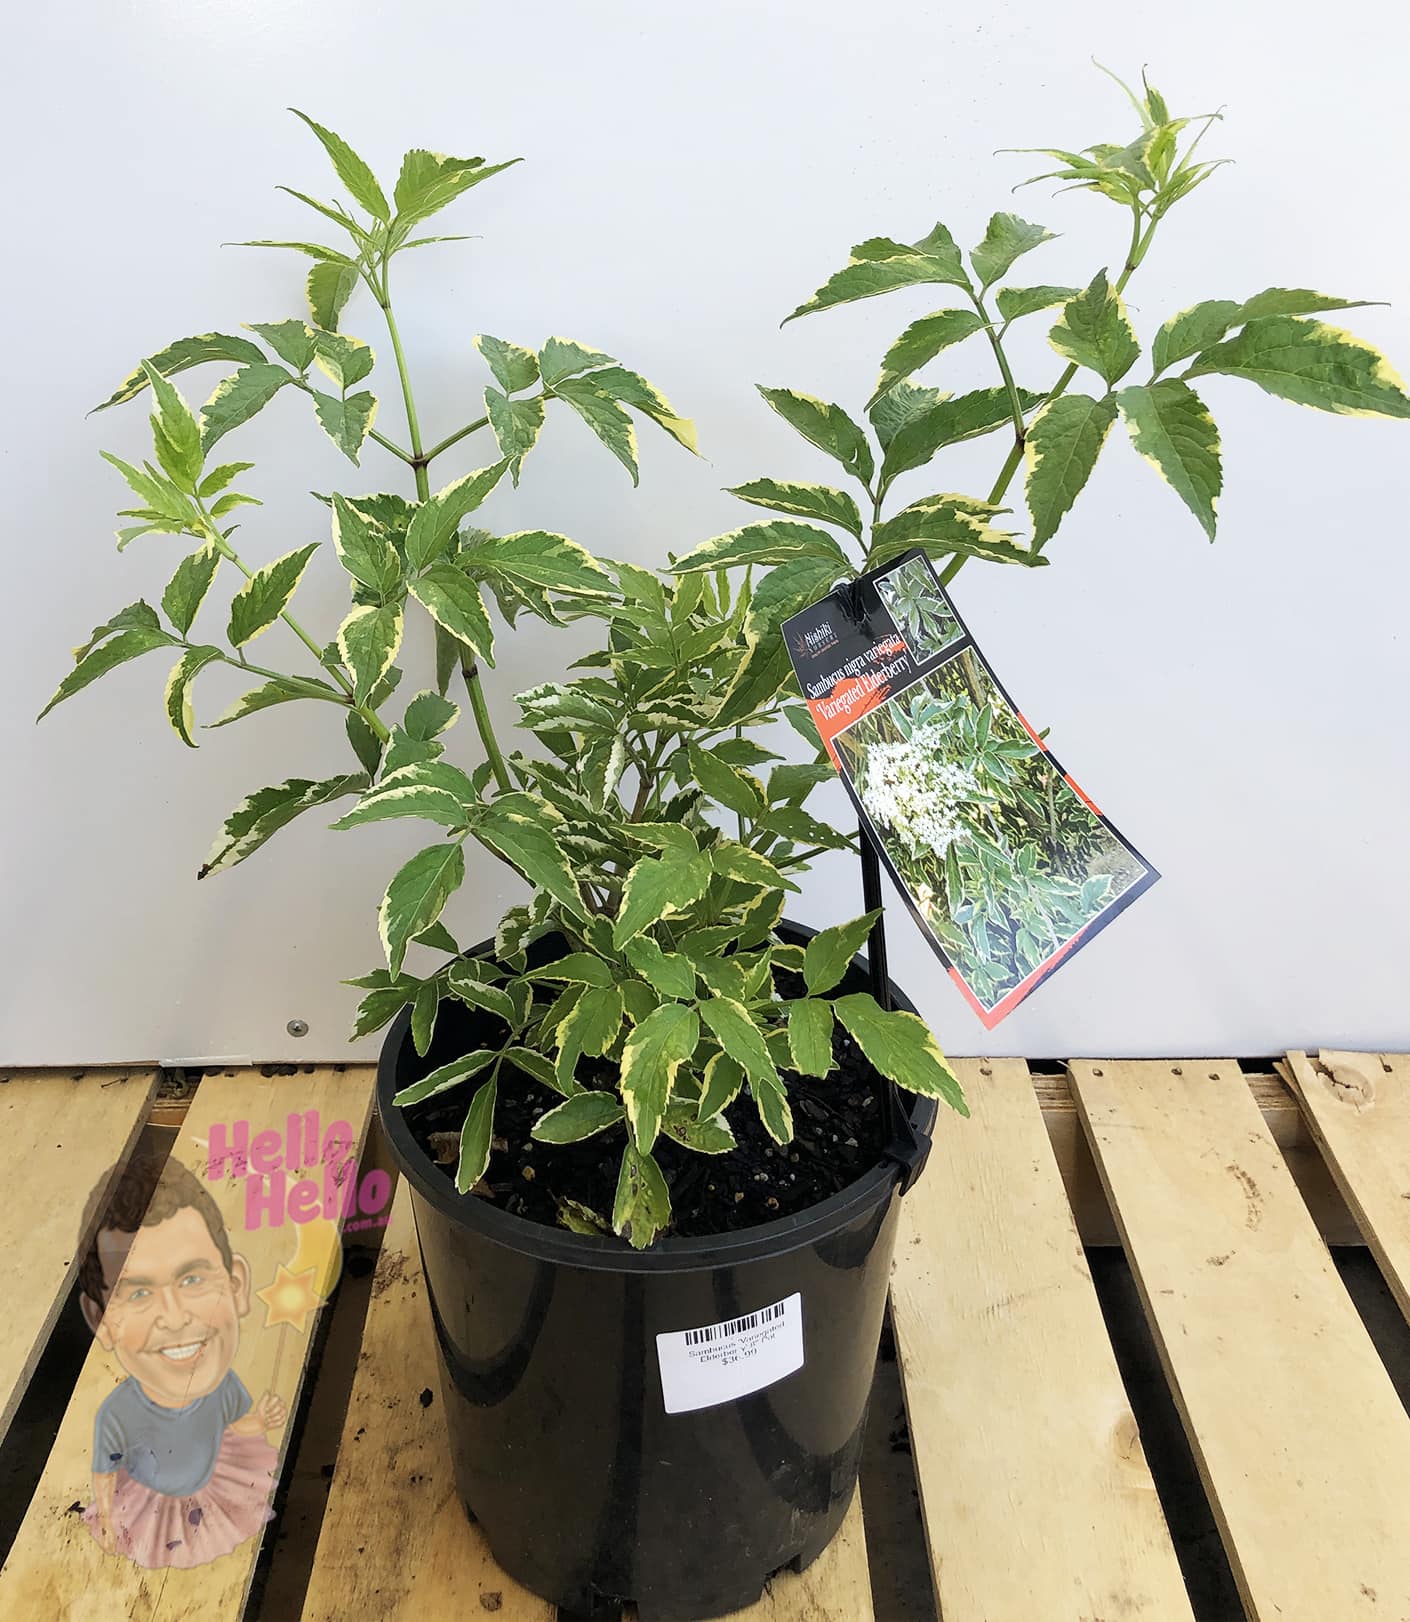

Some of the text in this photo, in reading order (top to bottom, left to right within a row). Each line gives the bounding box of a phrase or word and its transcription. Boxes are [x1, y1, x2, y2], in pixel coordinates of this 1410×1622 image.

[804, 621, 833, 647] Nishiki
[806, 667, 846, 700] Sambucus
[844, 656, 866, 676] nigra
[863, 633, 902, 661] variegata
